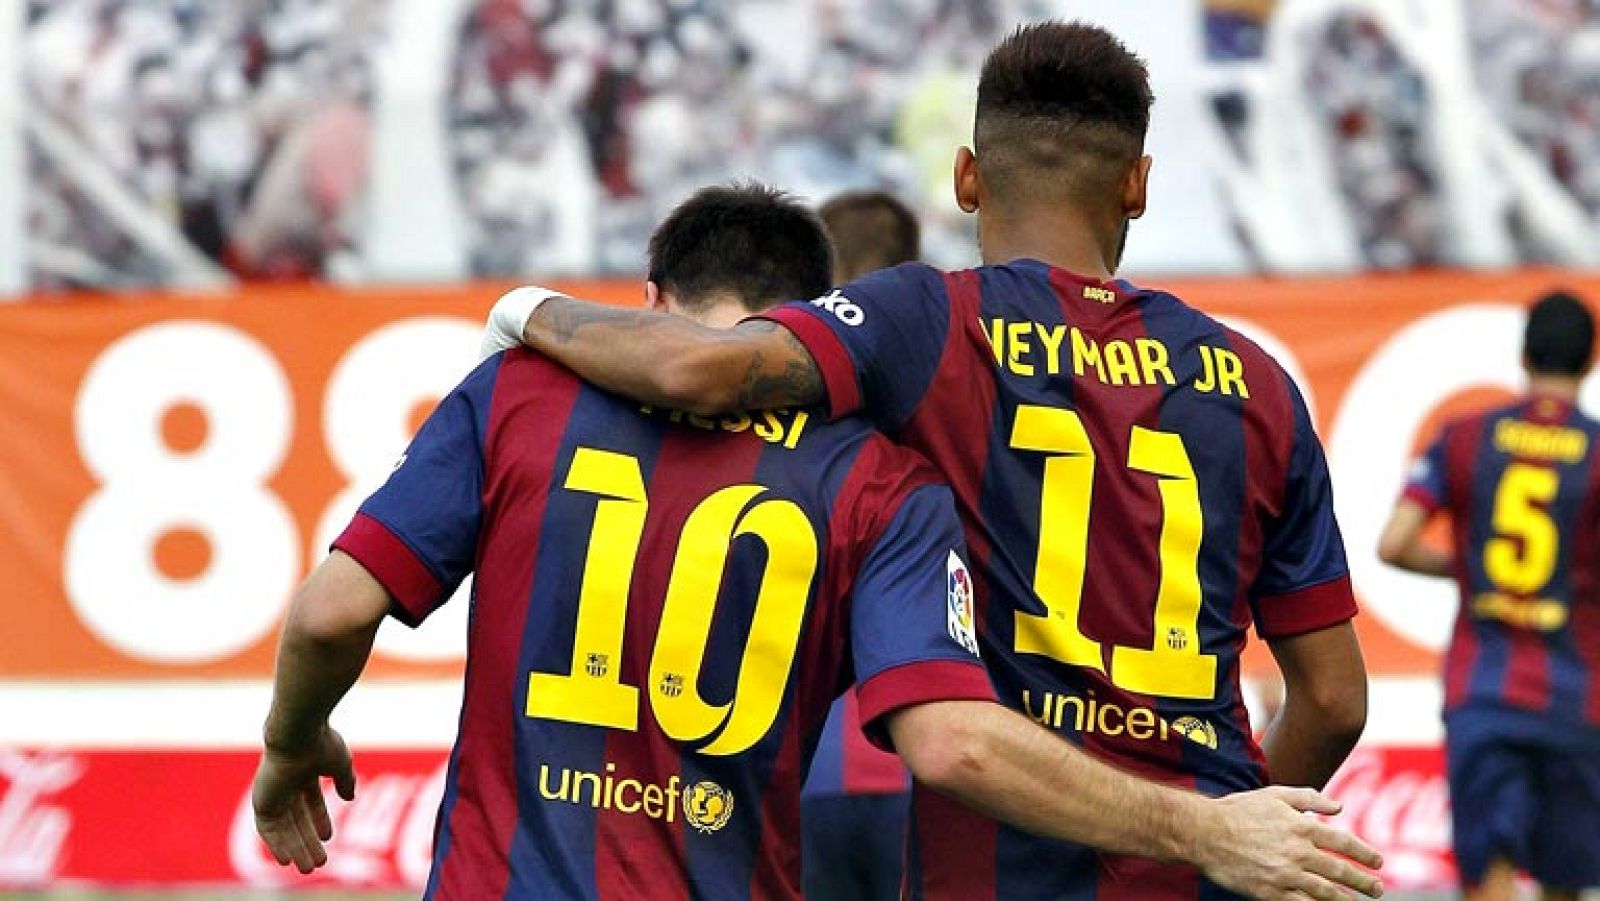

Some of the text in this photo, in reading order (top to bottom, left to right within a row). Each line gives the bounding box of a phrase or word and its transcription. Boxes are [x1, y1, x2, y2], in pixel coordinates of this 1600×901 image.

[977, 317, 1250, 399] NEYMAR JR
[1010, 404, 1218, 700] 11
[1482, 462, 1560, 596] 5
[525, 446, 819, 756] 10
[538, 762, 681, 823] unicef
